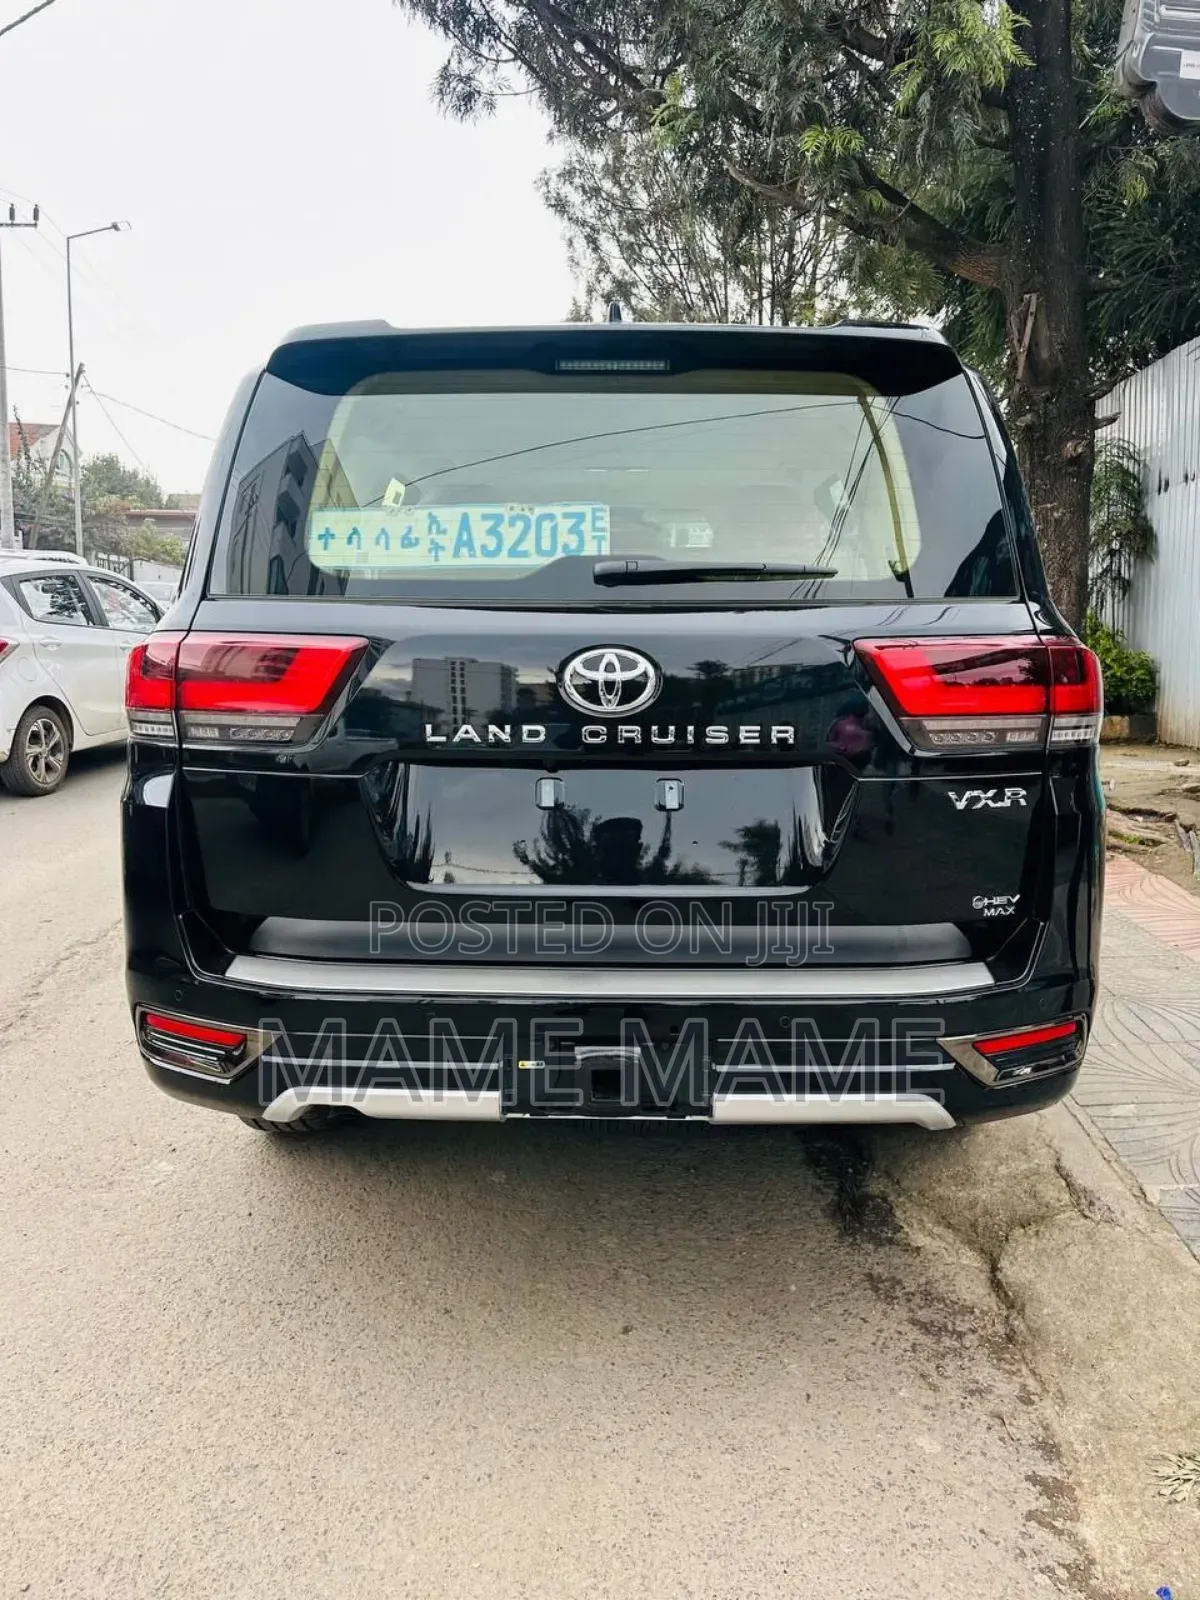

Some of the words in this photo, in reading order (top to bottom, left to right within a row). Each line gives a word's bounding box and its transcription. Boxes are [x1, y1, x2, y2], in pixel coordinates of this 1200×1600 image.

[452, 511, 587, 559] A3203
[424, 723, 547, 744] LAND
[580, 724, 796, 745] CRUISER
[947, 787, 1027, 810] VXR
[983, 905, 1016, 917] MAX
